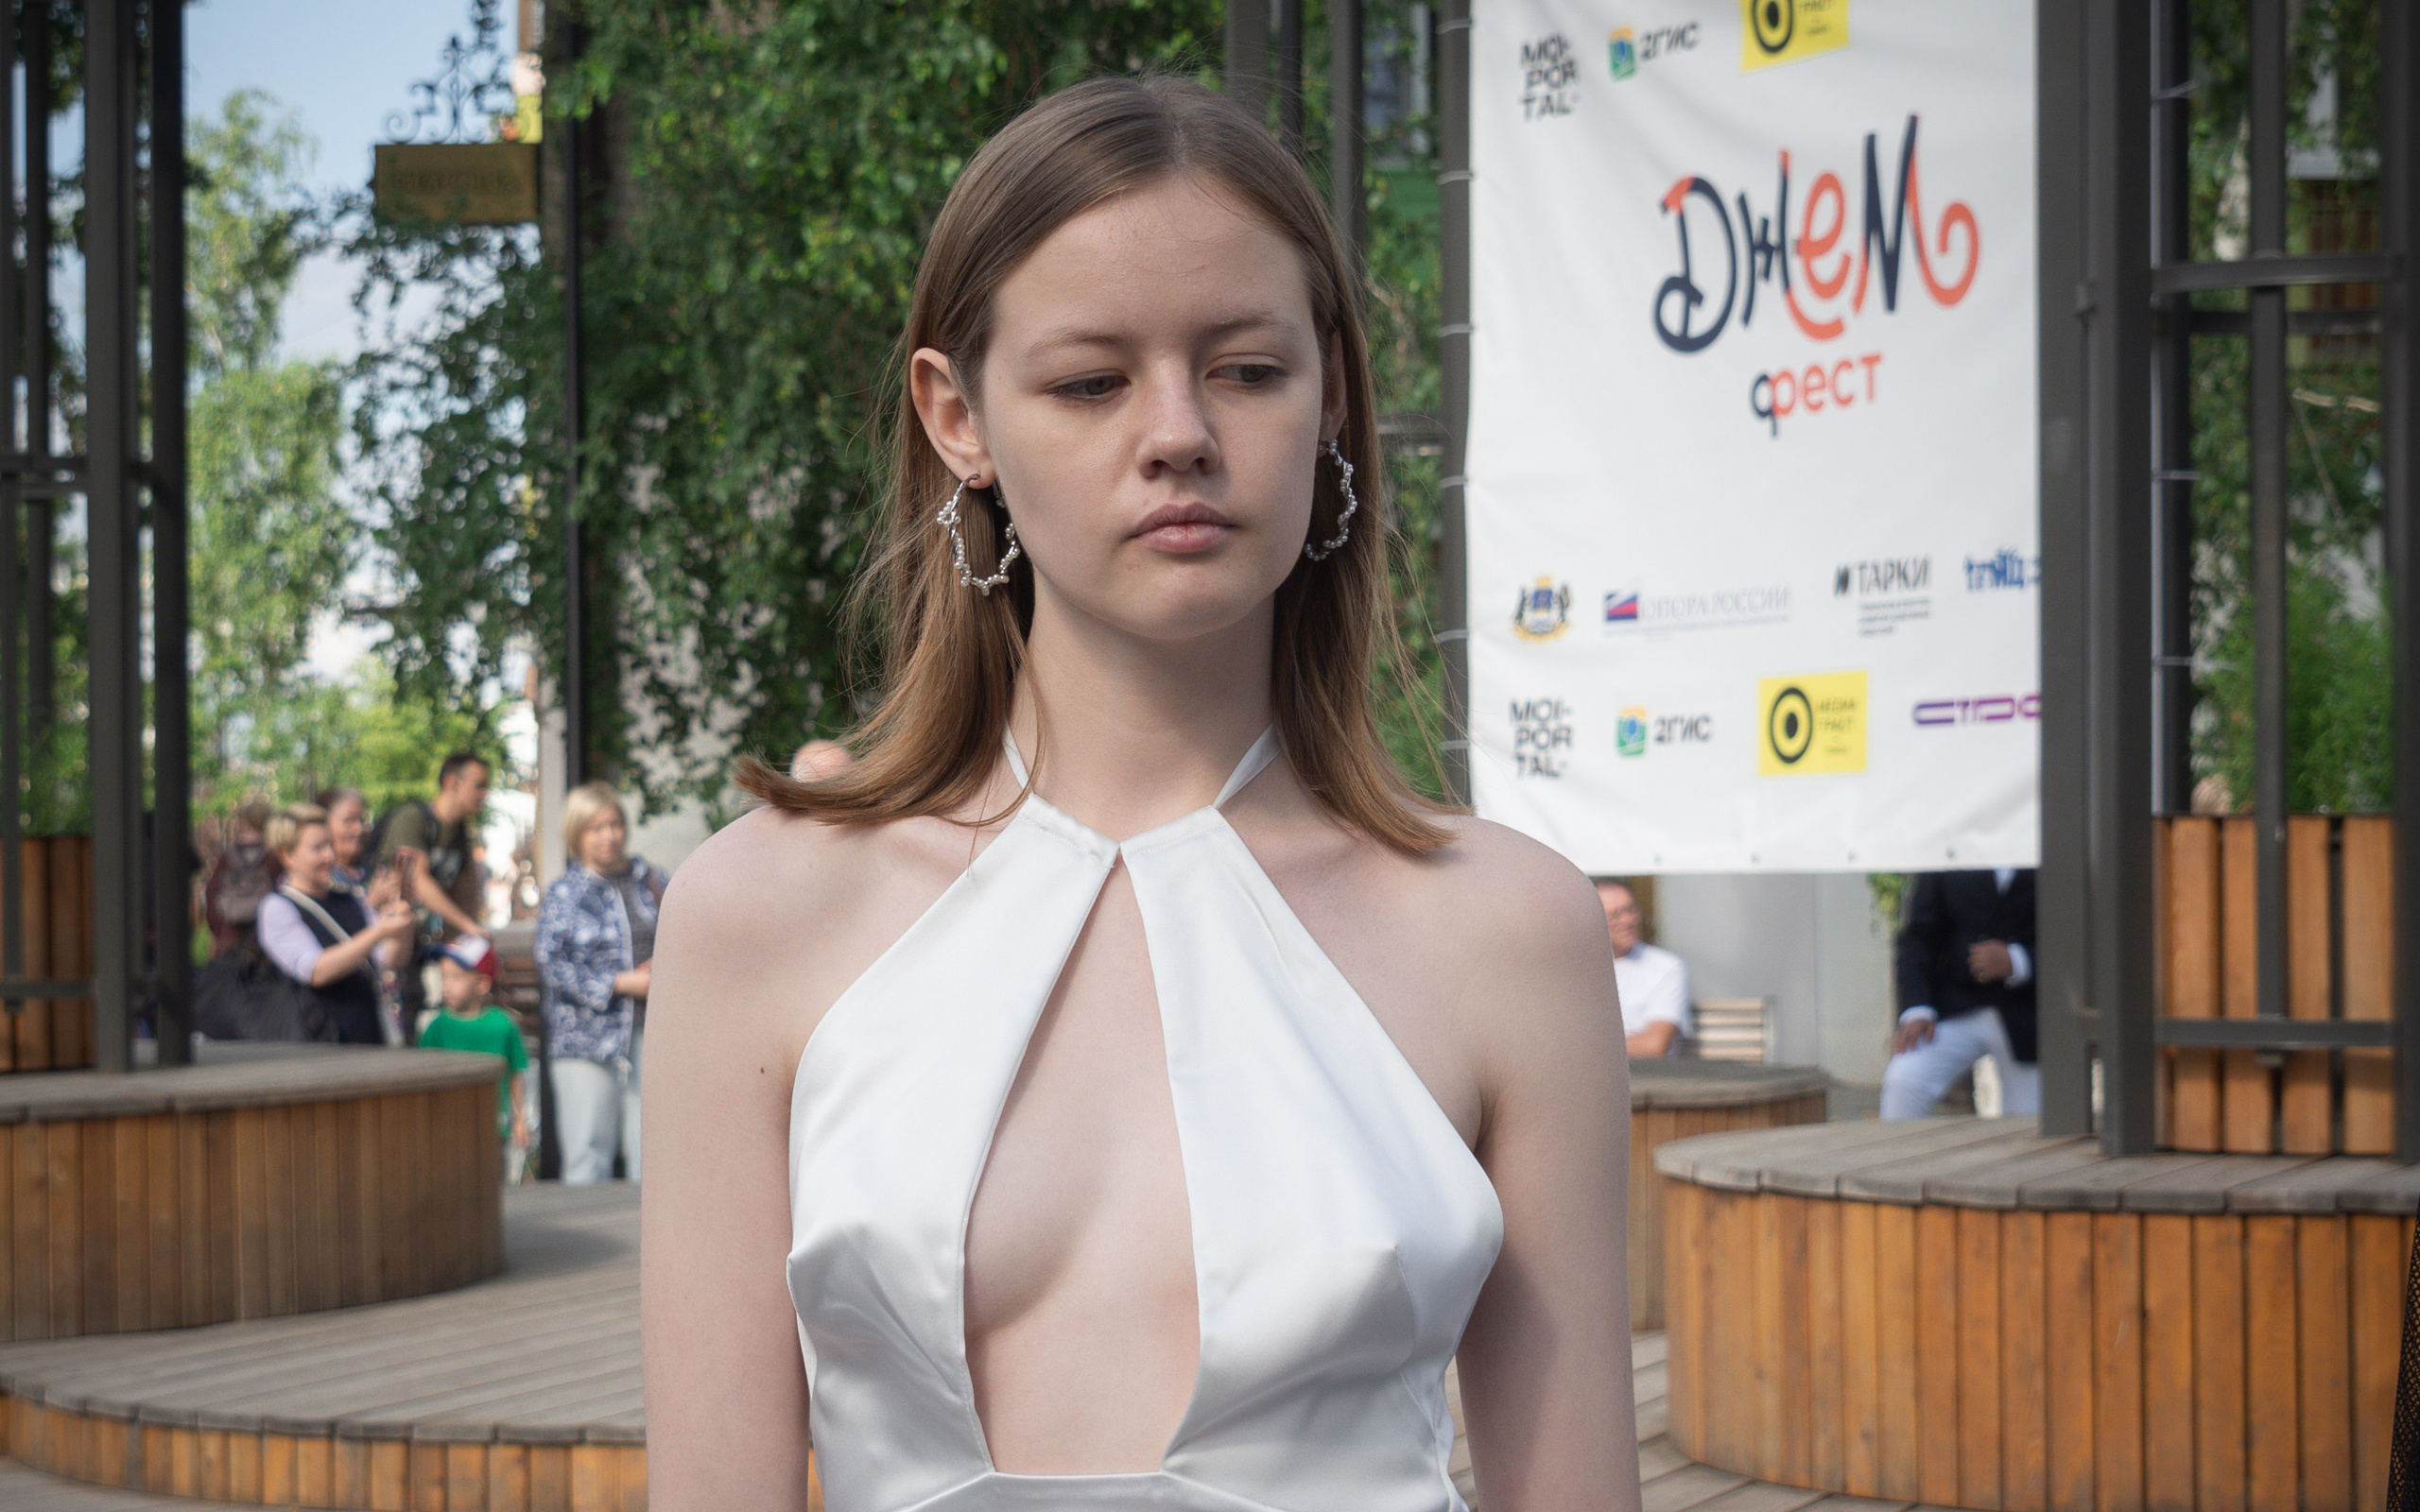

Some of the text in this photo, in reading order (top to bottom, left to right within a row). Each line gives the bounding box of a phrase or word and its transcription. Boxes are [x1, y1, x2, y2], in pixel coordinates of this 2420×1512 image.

[1640, 23, 1700, 61] 2ГИС
[1525, 59, 1577, 92] POR
[1641, 587, 1790, 620] ОПОРА РОССИИ
[1514, 725, 1572, 752] POR
[1653, 715, 1712, 744] 2ГИС
